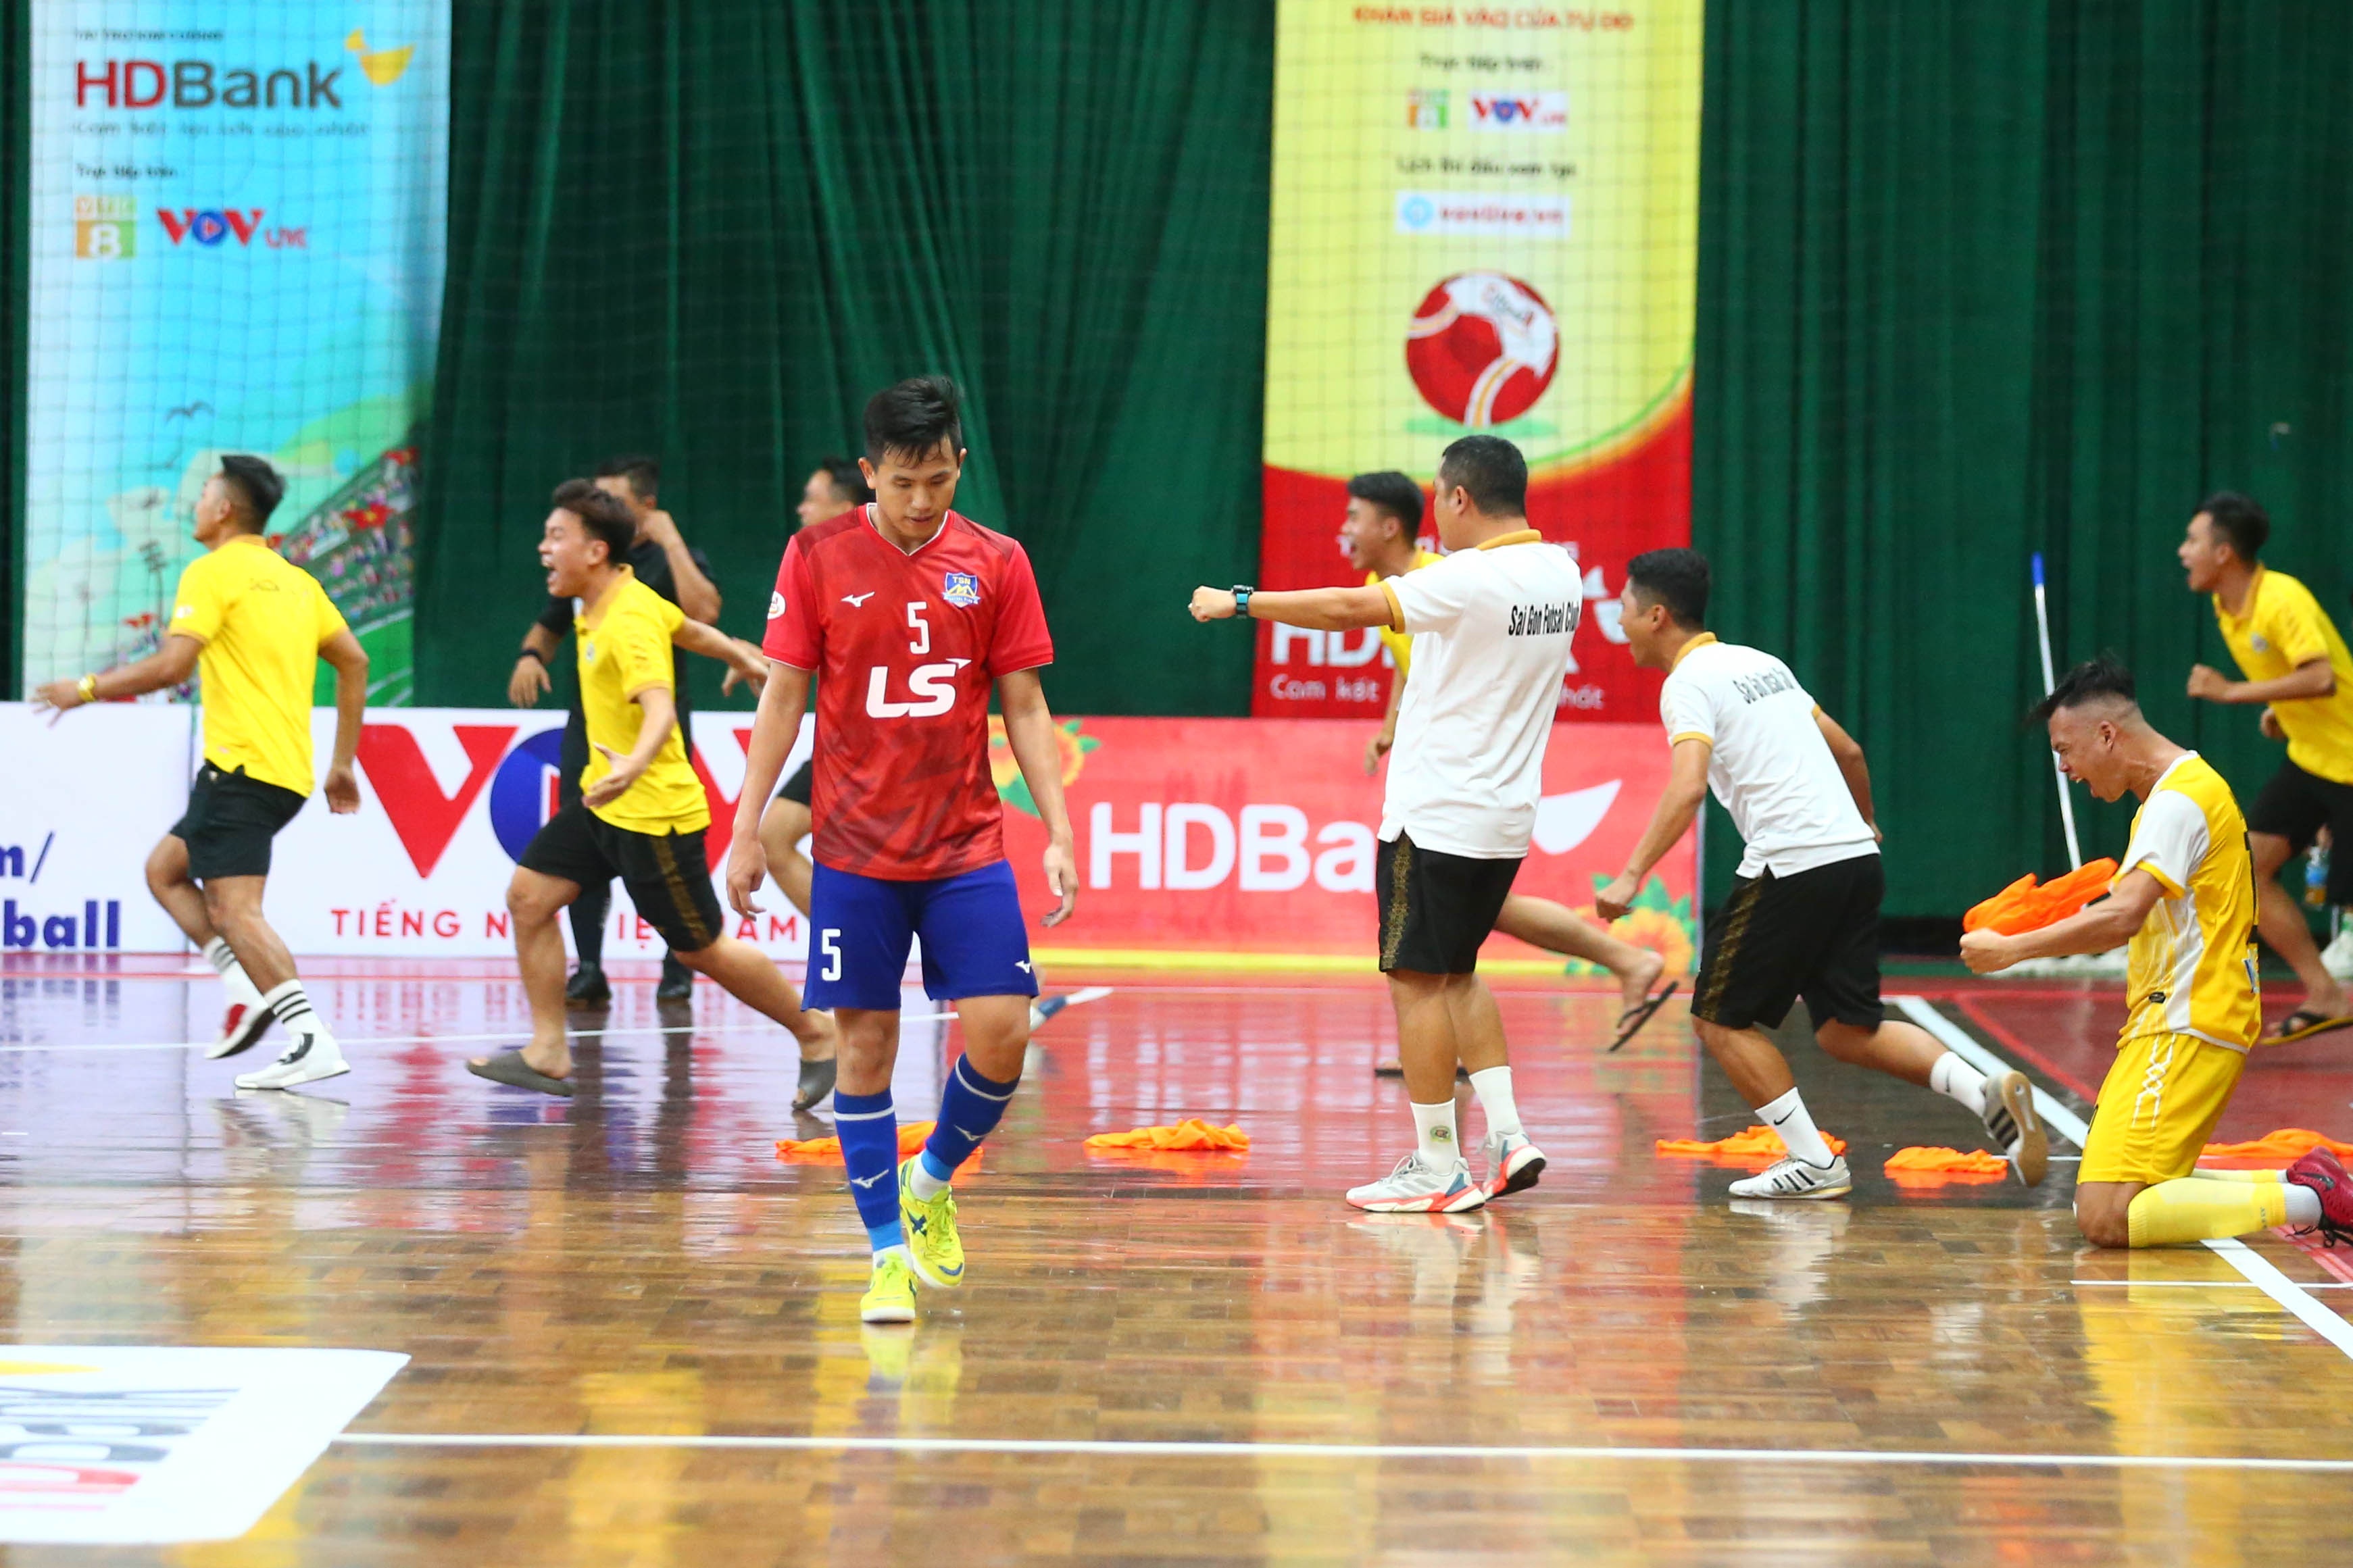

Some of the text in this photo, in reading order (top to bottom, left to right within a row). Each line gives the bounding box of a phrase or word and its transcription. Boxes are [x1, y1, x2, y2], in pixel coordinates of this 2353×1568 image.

[76, 59, 343, 108] HDBank
[156, 207, 265, 247] VOV
[952, 576, 971, 585] TSN
[908, 601, 931, 655] 5
[1508, 605, 1527, 636] Sai
[1527, 605, 1542, 636] Gon
[1543, 602, 1565, 634] Futsal
[866, 663, 958, 718] LS
[1270, 674, 1326, 701] Cam
[1090, 802, 1376, 892] HDBa
[330, 899, 461, 938] TIẾNG
[722, 915, 797, 941] AM
[821, 928, 841, 981] 5
